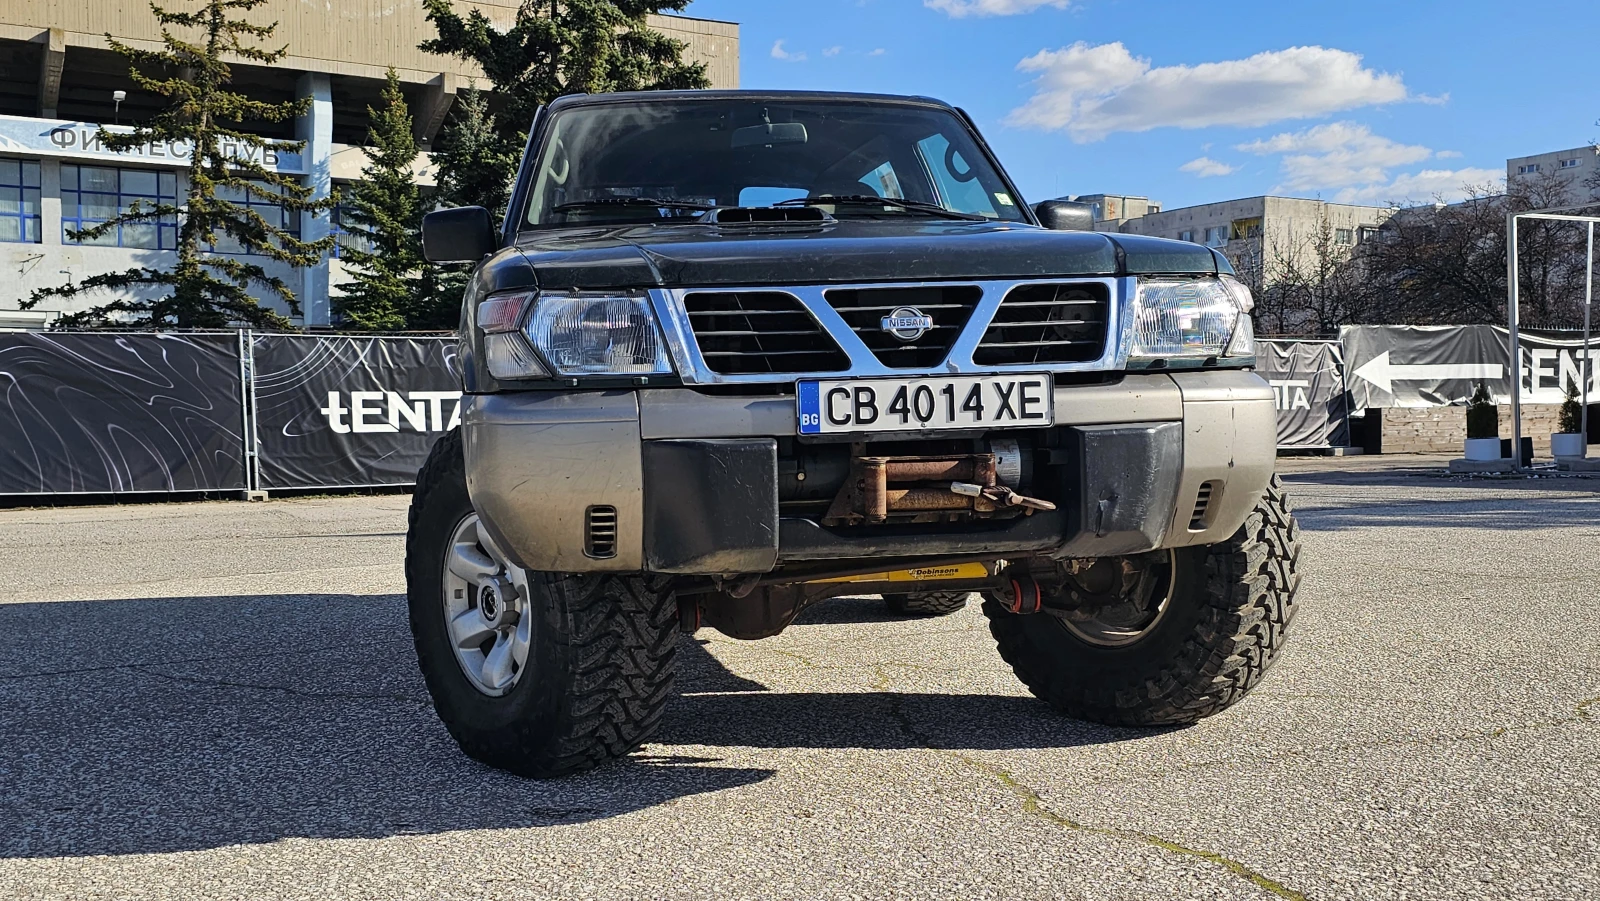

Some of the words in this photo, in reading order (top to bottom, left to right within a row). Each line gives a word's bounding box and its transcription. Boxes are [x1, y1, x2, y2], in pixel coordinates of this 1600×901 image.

[51, 128, 188, 158] ФИЕС
[888, 318, 927, 328] NISSAN
[828, 386, 879, 425] CB
[889, 383, 984, 423] 4014
[994, 381, 1044, 421] XE
[802, 414, 819, 426] BG
